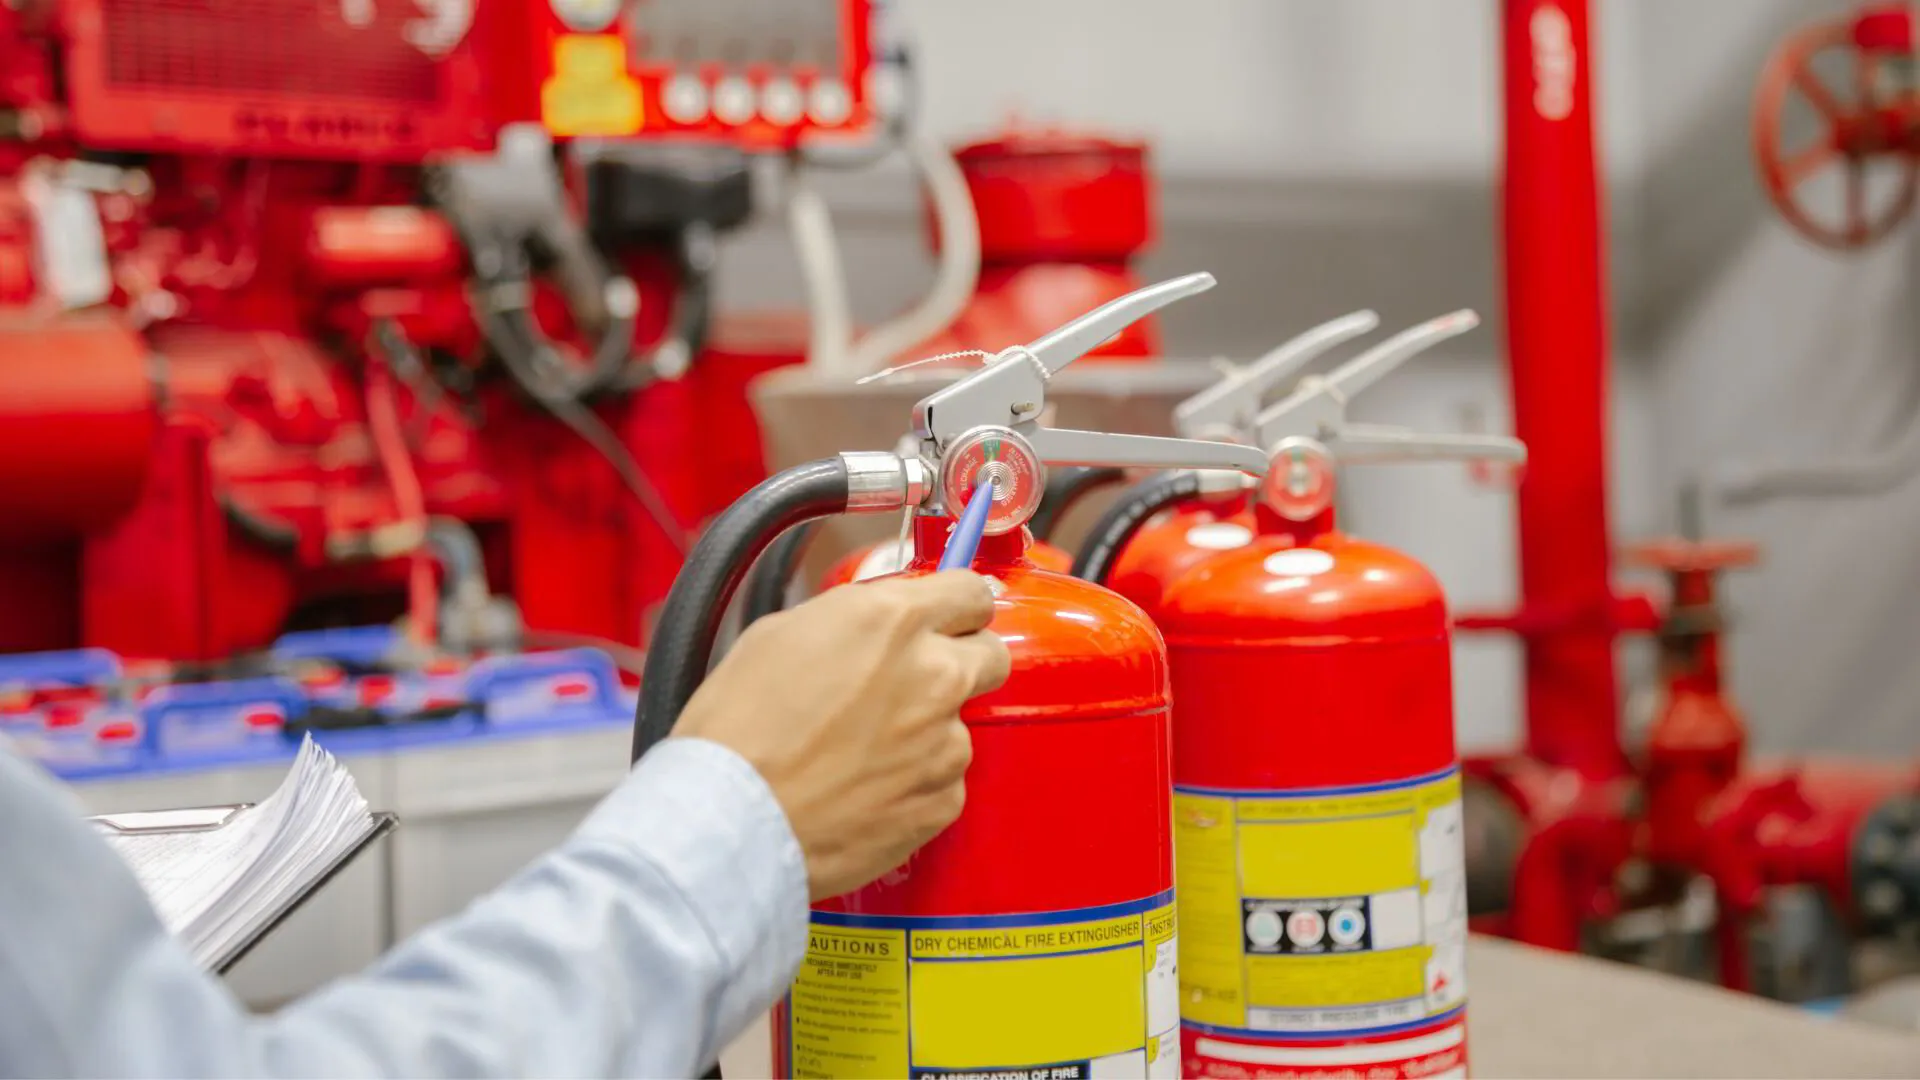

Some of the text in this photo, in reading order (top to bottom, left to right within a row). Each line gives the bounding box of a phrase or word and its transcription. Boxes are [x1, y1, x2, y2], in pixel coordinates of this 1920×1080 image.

[809, 936, 890, 956] AUTIONS
[914, 920, 1140, 952] DRY CHEMICAL FIRE EXTINGUISHER
[1031, 1069, 1049, 1080] OF
[1051, 1066, 1080, 1079] FIRE
